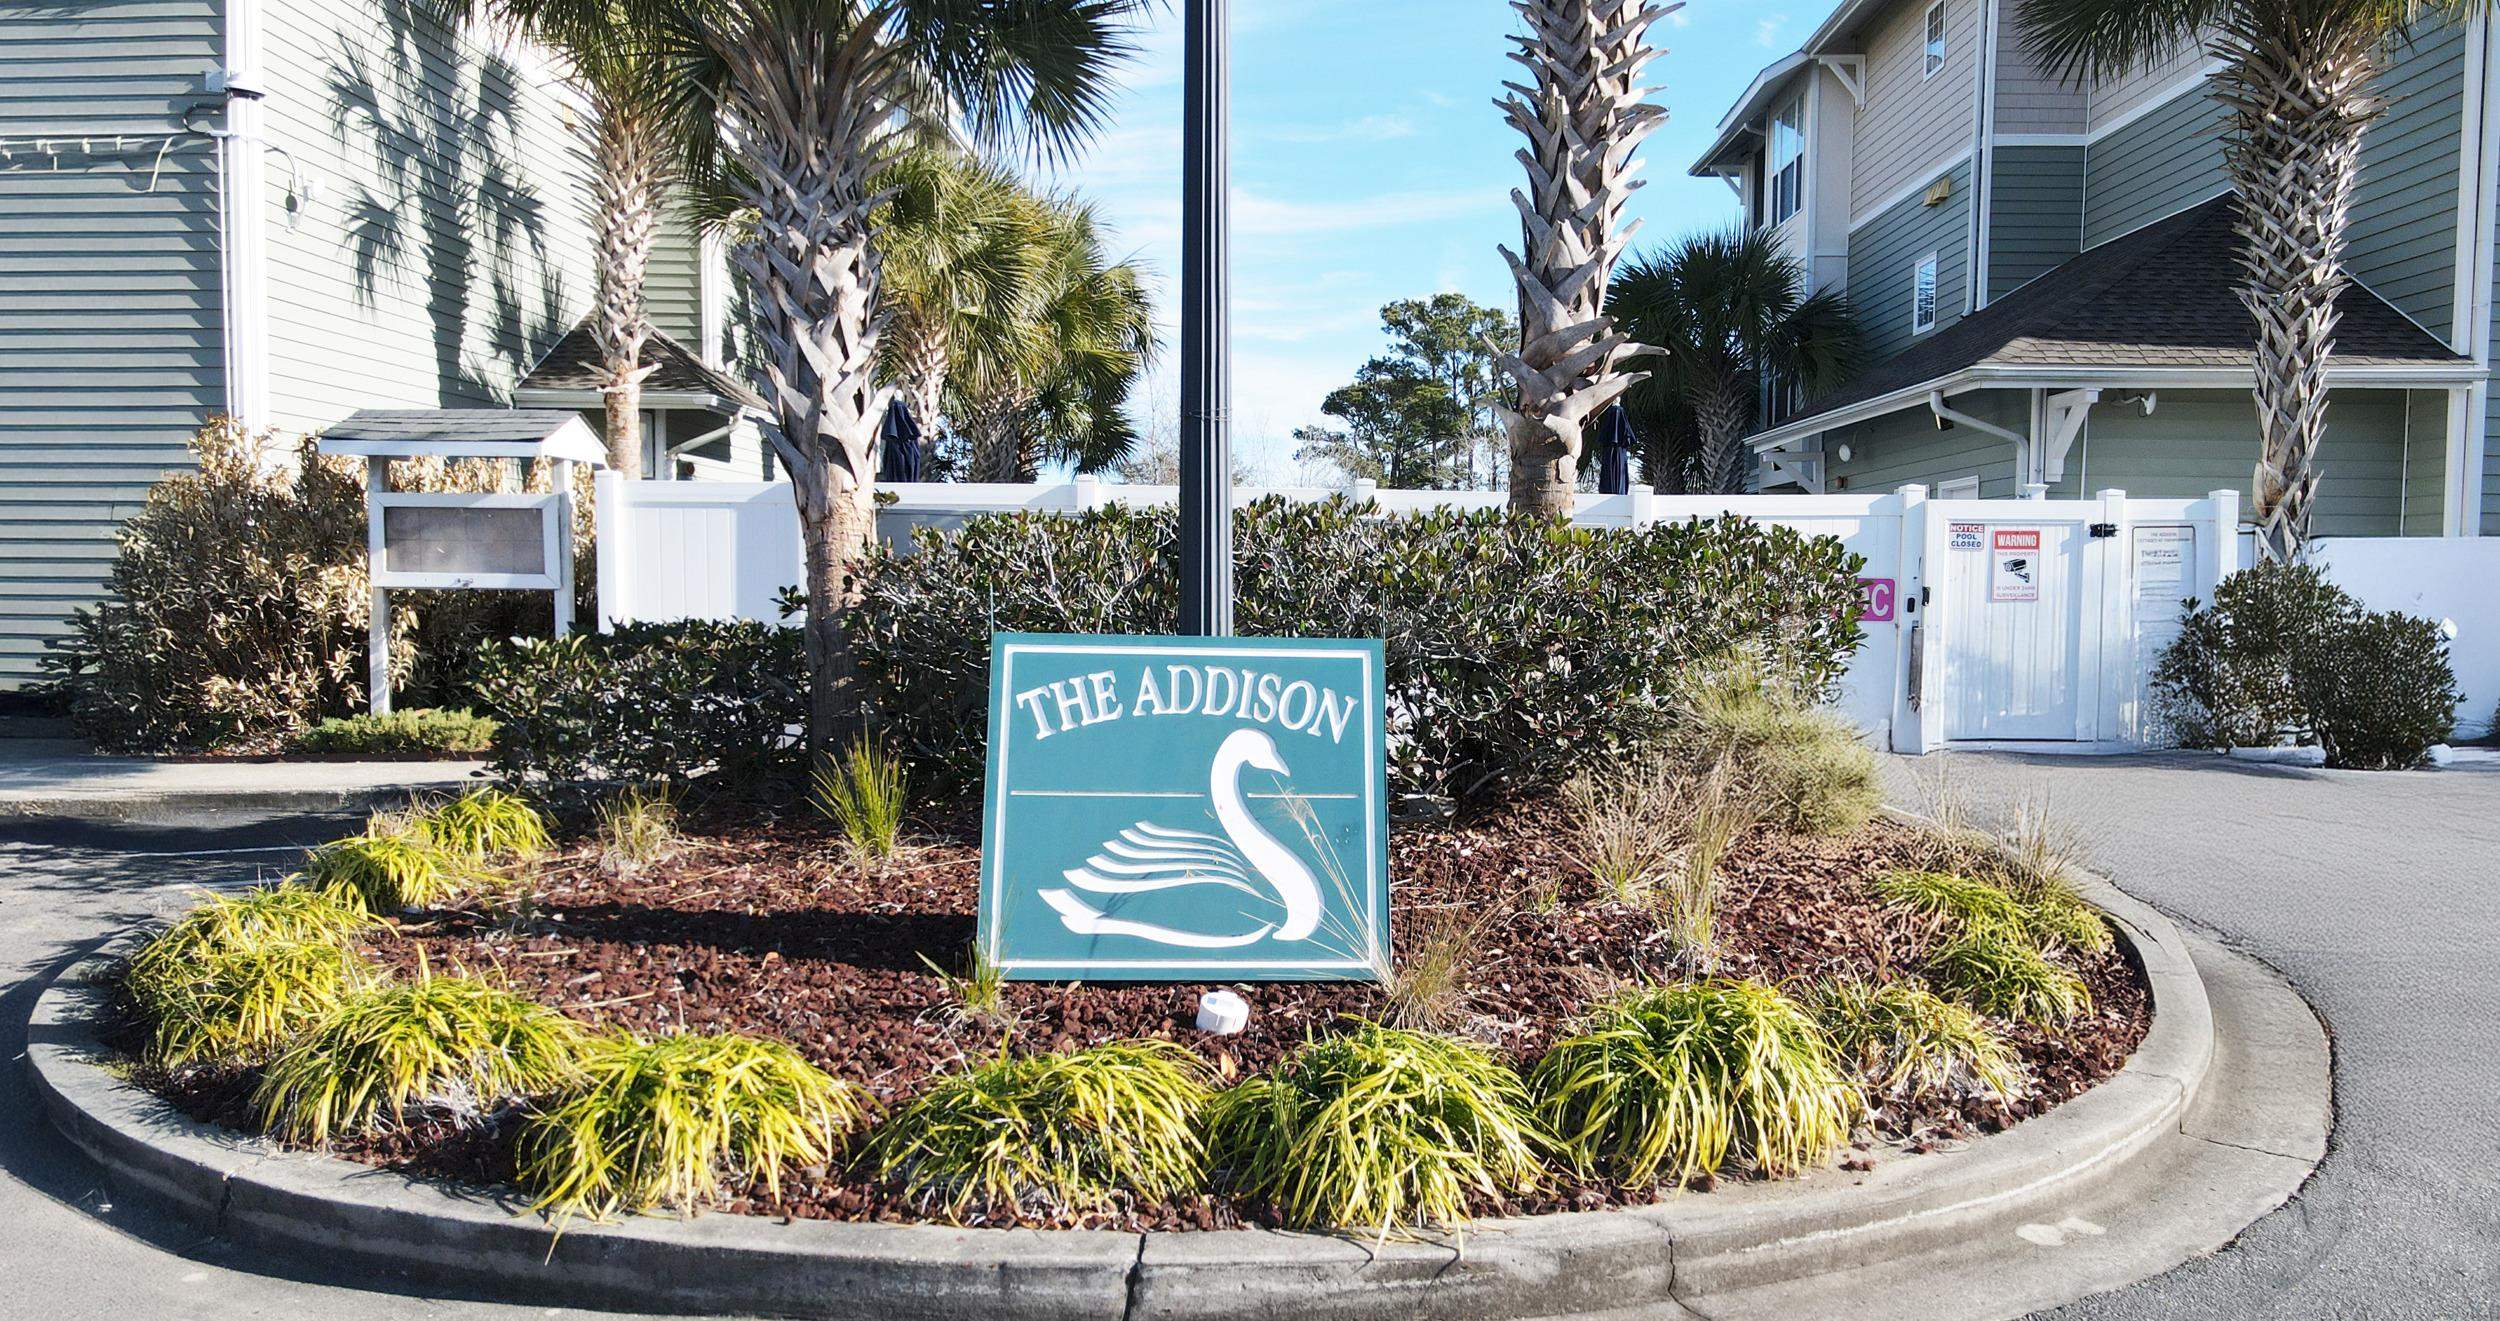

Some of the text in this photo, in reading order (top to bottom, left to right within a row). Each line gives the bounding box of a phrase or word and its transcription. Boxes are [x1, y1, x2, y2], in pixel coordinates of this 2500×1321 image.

[1950, 525, 1984, 533] NOTICE
[1997, 535, 2037, 547] WARNING
[1016, 664, 1359, 745] THE ADDISON
